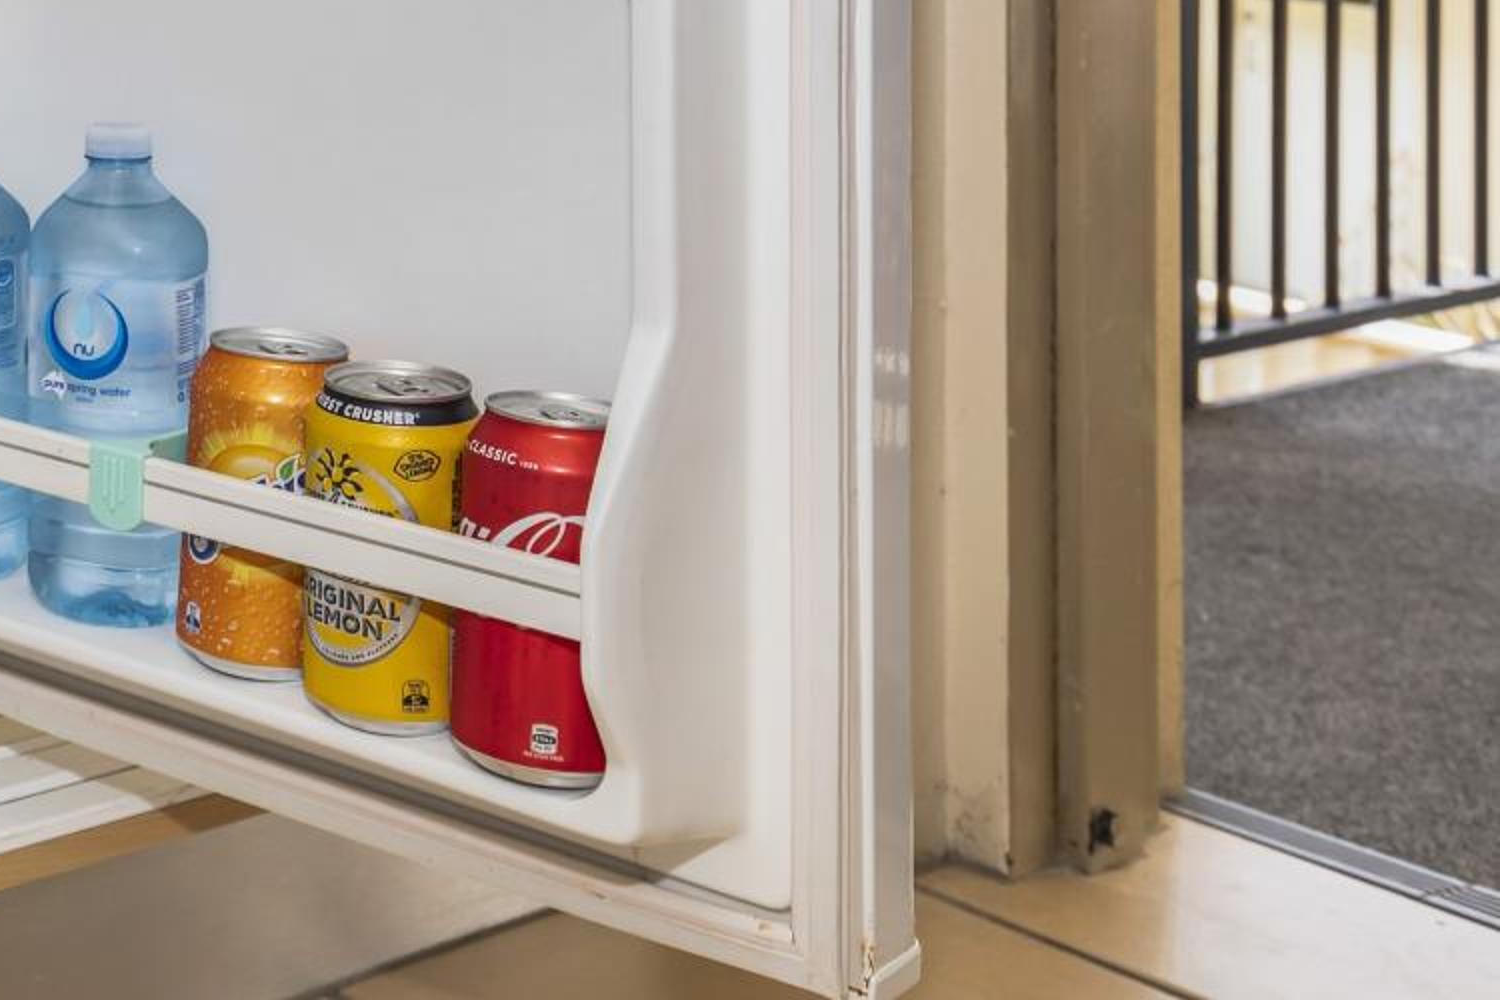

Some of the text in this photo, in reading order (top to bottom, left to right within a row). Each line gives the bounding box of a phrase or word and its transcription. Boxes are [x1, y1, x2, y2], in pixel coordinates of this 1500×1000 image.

[73, 343, 95, 357] nu
[343, 402, 418, 426] CRUSHER
[469, 439, 518, 466] CLASSIC
[305, 576, 400, 622] RIGINAL
[307, 598, 383, 641] LEMON
